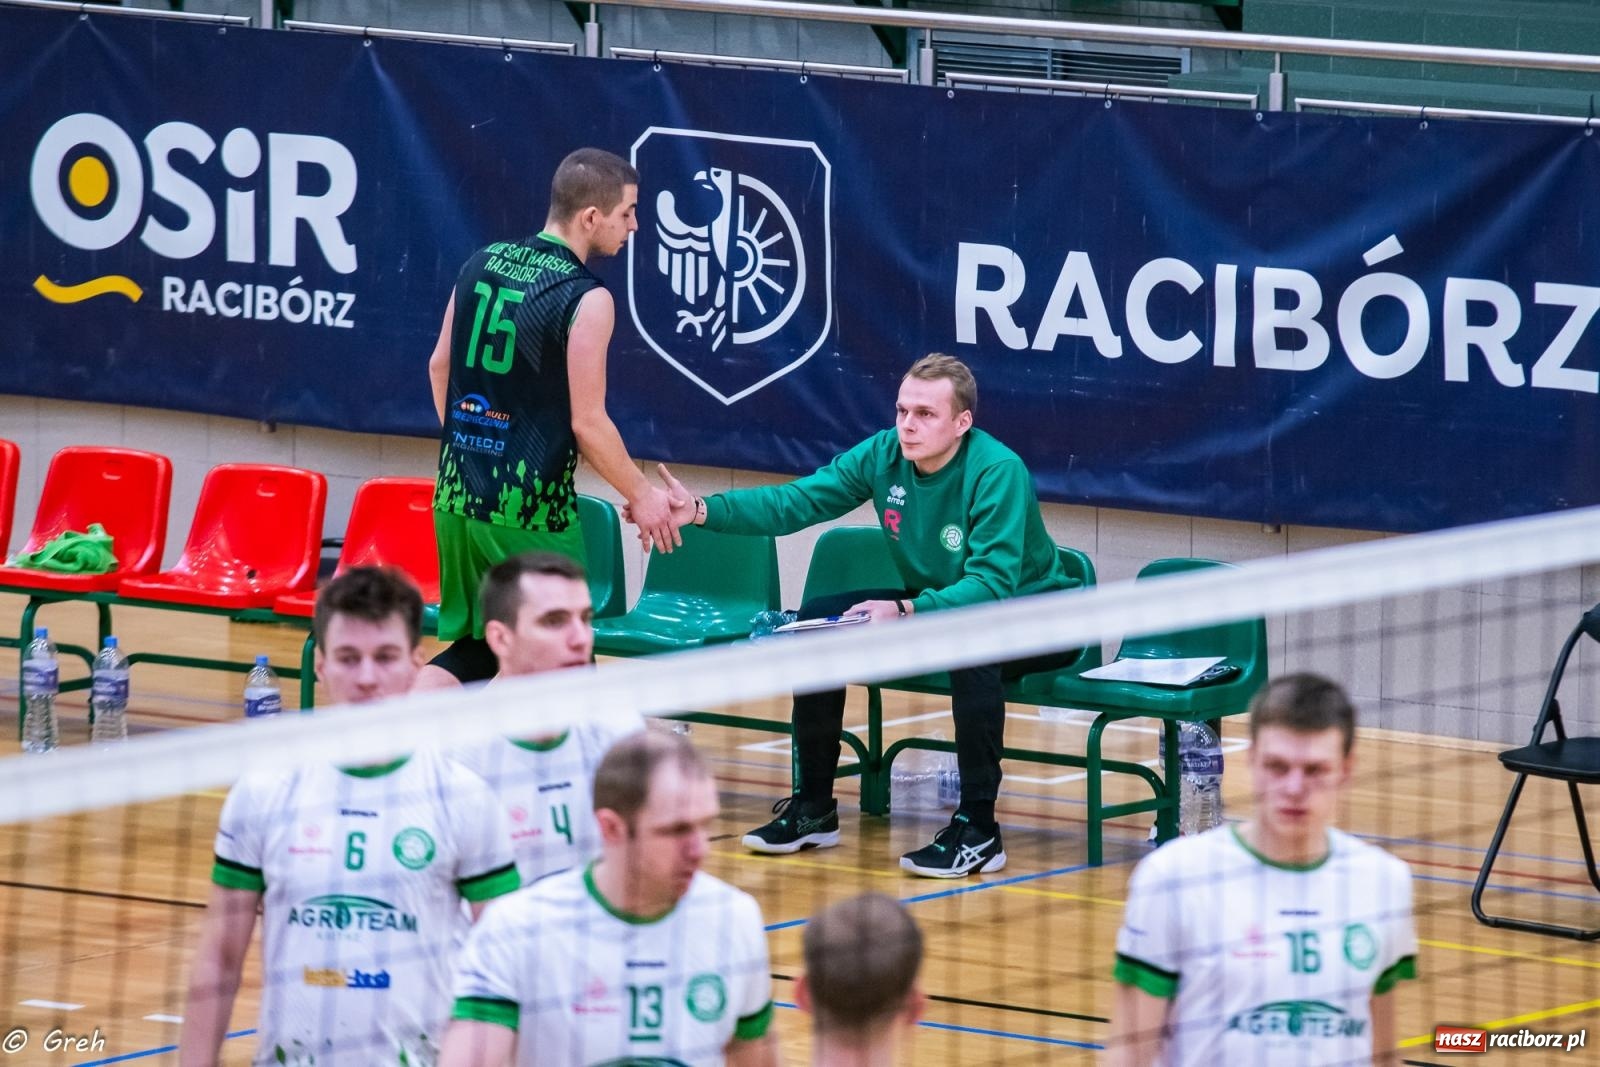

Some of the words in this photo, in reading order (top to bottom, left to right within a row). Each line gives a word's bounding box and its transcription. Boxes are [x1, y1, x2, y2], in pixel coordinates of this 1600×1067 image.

[162, 275, 357, 329] RACIBÓRZ
[955, 234, 1600, 393] RACIBÓRZ
[465, 281, 525, 375] 15
[485, 410, 510, 421] MULTI
[453, 431, 505, 451] NTECO
[884, 508, 902, 533] R
[551, 803, 573, 845] 4
[345, 831, 367, 871] 6
[1285, 929, 1321, 975] 16
[627, 984, 663, 1029] 13
